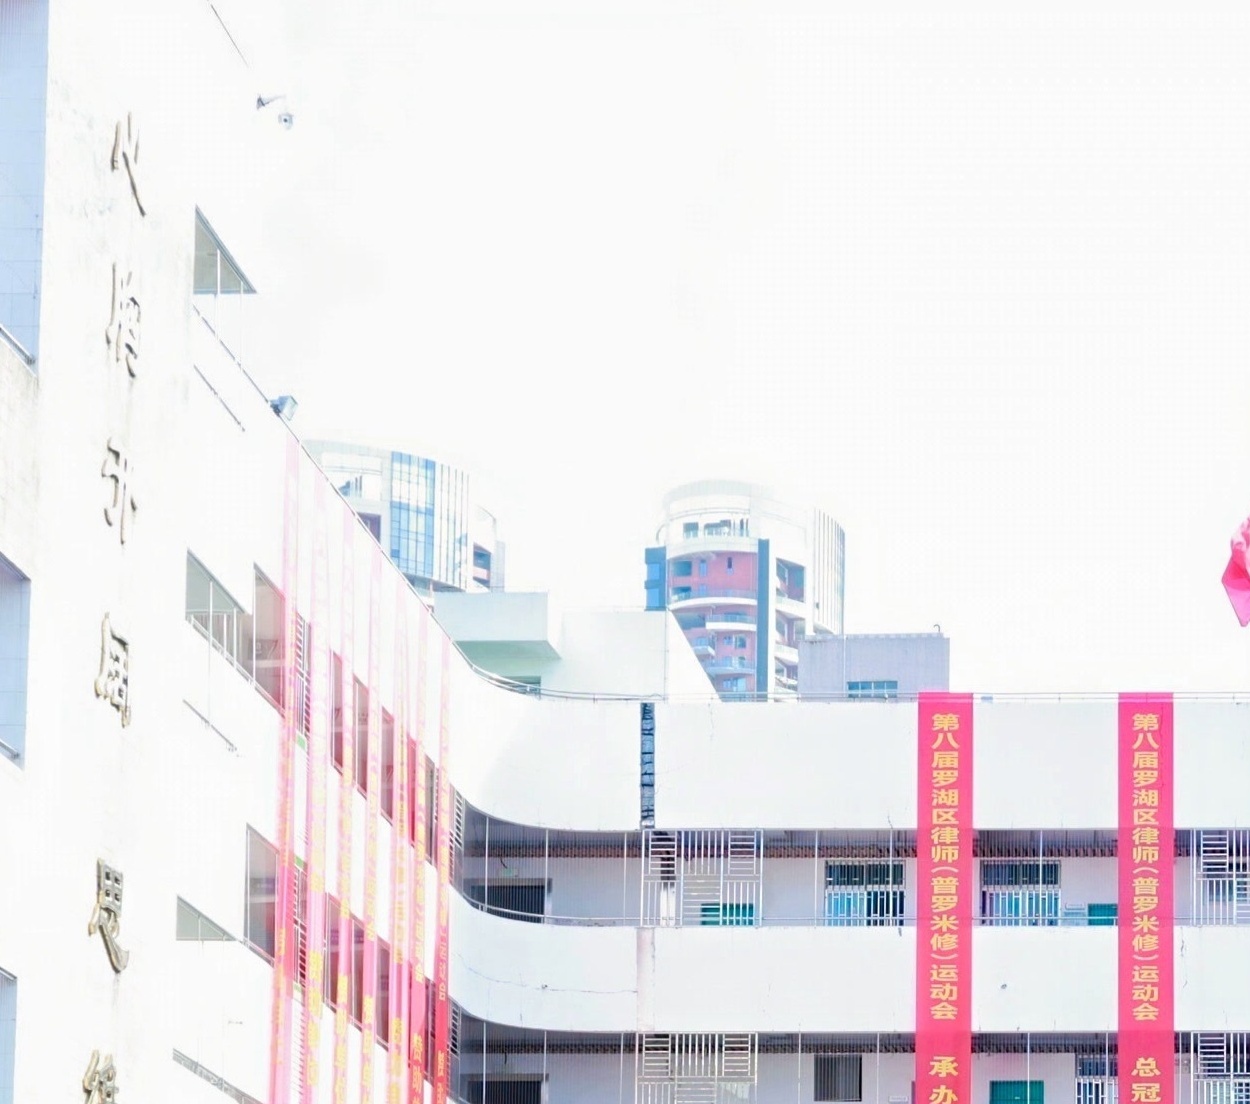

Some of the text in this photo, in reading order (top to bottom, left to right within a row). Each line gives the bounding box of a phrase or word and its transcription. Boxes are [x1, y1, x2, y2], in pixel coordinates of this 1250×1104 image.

[930, 713, 960, 1020] 第八届罗湖区律师（普罗米修）运动会
[1132, 713, 1160, 1021] 第八届罗湖区律师（普罗米修）运动会
